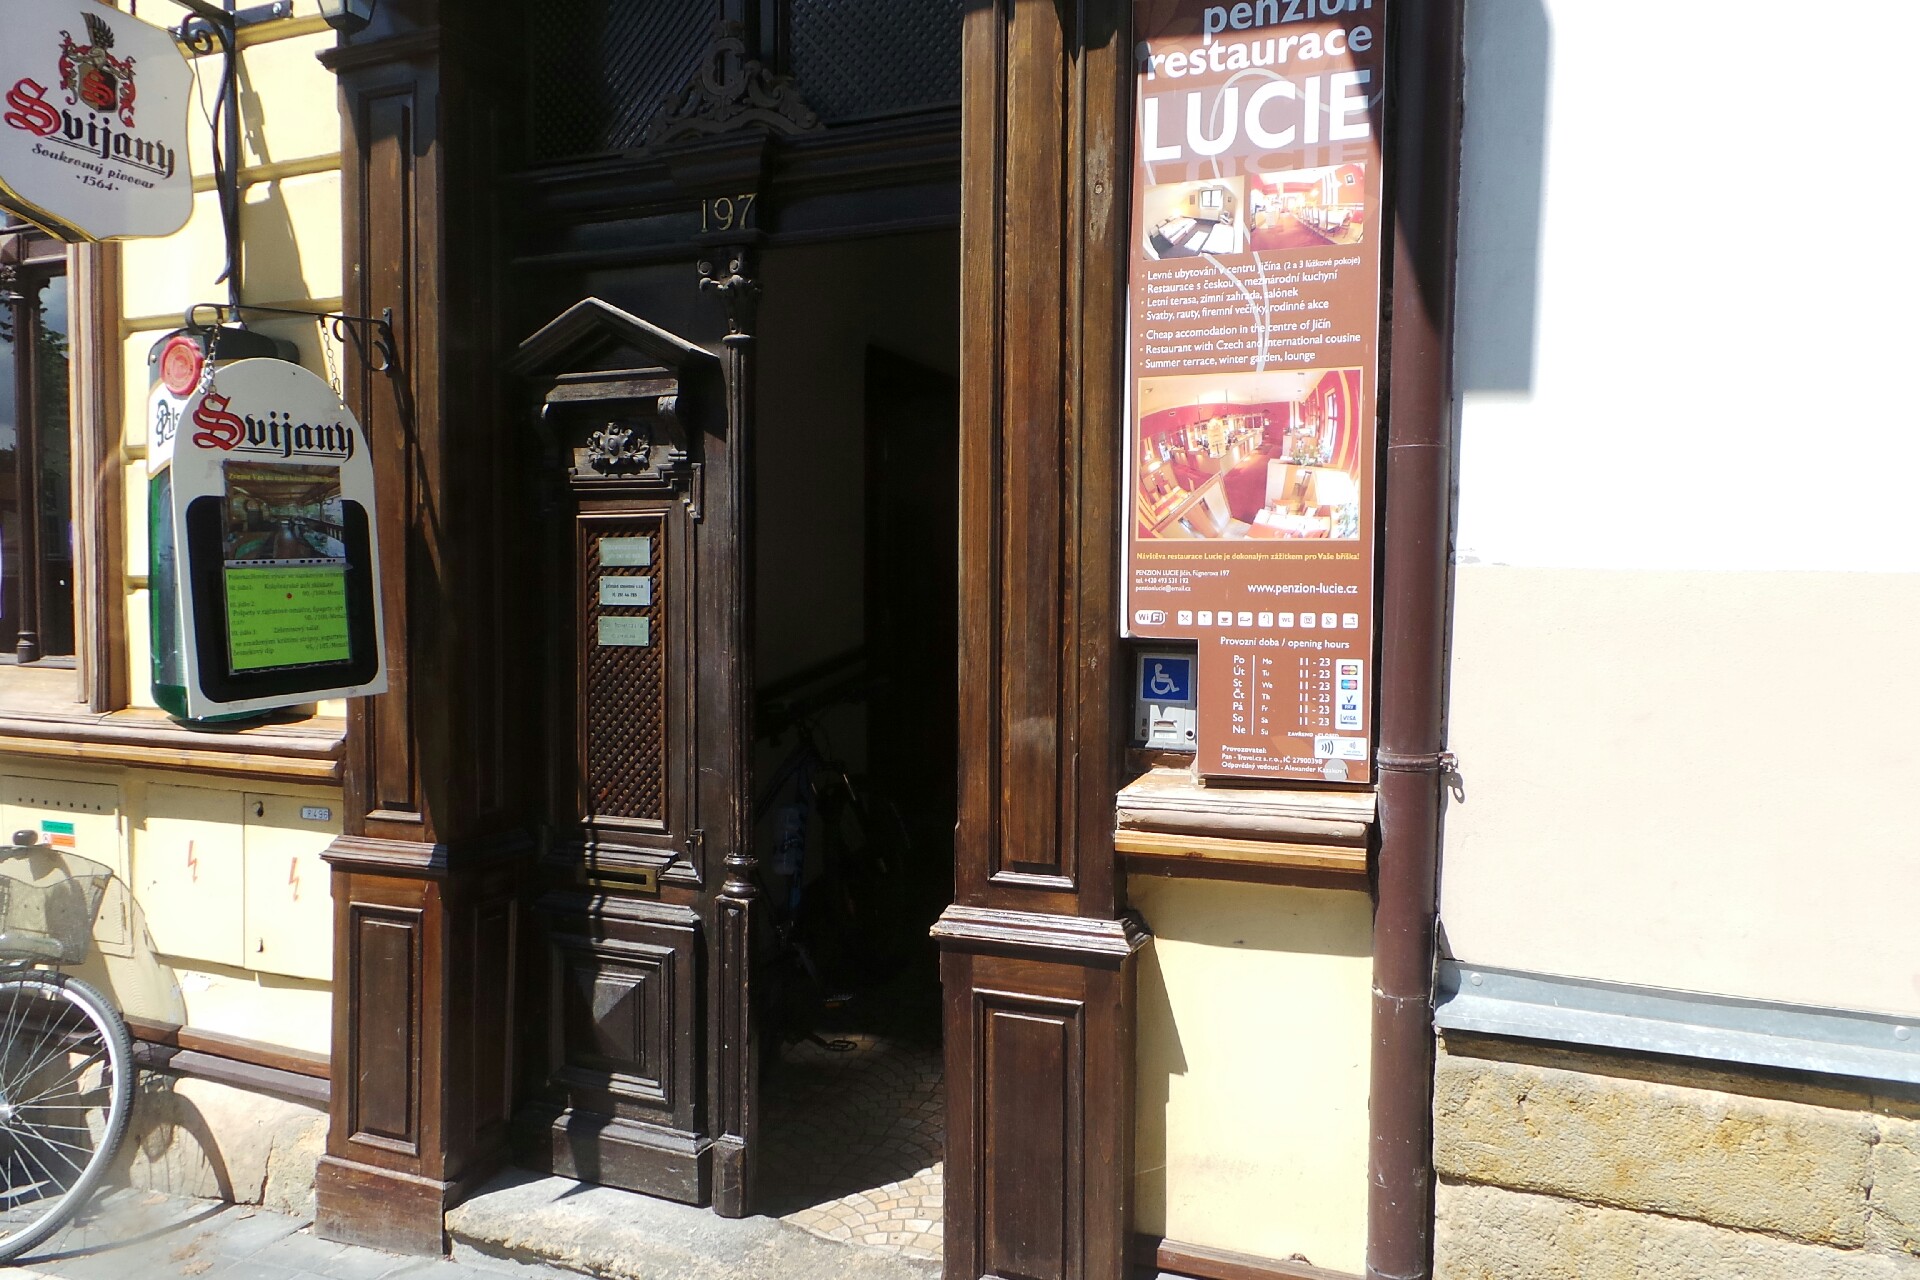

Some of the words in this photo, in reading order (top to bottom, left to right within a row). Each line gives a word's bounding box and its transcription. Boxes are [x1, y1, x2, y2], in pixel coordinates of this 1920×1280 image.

[1147, 25, 1373, 80] restaurace
[1143, 70, 1371, 161] LUCIE
[4, 77, 174, 180] Svijany
[32, 143, 104, 176] Soukromý
[107, 168, 155, 190] pivovar
[701, 193, 758, 233] 197
[1147, 269, 1172, 281] Levné
[1226, 264, 1256, 274] centru
[1299, 260, 1304, 268] 3
[1147, 282, 1194, 294] Restaurace
[1203, 279, 1234, 290] českou
[1302, 269, 1338, 283] kuchyní
[1147, 295, 1168, 307] Letní
[1170, 296, 1199, 306] terasa,
[1200, 292, 1224, 303] zimní
[1225, 289, 1262, 301] zahrada,
[1264, 287, 1299, 298] salónek
[1146, 310, 1175, 322] Svatby,
[1176, 309, 1200, 320] rauty,
[1202, 305, 1234, 316] firemní
[1269, 300, 1305, 312] rodinné
[1307, 300, 1329, 310] akce
[1146, 330, 1174, 341] Cheap
[1175, 325, 1237, 338] accomodation
[1239, 324, 1248, 333] in
[1250, 322, 1265, 333] the
[1268, 322, 1297, 332] centre
[1299, 319, 1310, 329] of
[1311, 318, 1331, 332] Jičín
[1145, 344, 1192, 354] Restaurant
[1194, 341, 1214, 351] with
[1216, 339, 1243, 349] Czech
[1246, 338, 1263, 349] and
[1264, 334, 1323, 347] international
[1325, 333, 1361, 344] cousine
[1145, 358, 1180, 369] Summer
[1183, 357, 1217, 366] terrace,
[1218, 354, 1248, 364] winter
[1249, 352, 1283, 365] garden,
[1284, 351, 1316, 363] lounge
[193, 392, 355, 462] Svijany
[1204, 552, 1222, 560] Lucie
[1223, 553, 1230, 561] je
[1317, 552, 1334, 560] Vaše
[1135, 569, 1161, 577] PENZION
[1162, 569, 1179, 577] LUCIE
[1247, 582, 1358, 596] www.penzion-lucie.cz
[1220, 636, 1257, 646] Provozní
[1258, 638, 1279, 647] doba
[1287, 640, 1323, 650] opening
[1324, 640, 1350, 649] hours
[1233, 655, 1245, 664] Po
[1318, 658, 1331, 666] 23
[1233, 665, 1246, 676] Út
[1261, 669, 1270, 677] Tu
[1318, 670, 1331, 678] 23
[1233, 678, 1243, 688] St
[1318, 682, 1331, 690] 23
[1232, 688, 1245, 699] Čt
[1318, 694, 1331, 702] 23
[1232, 701, 1243, 711] Pá
[1318, 706, 1331, 714] 23
[1232, 713, 1244, 722] So
[1318, 718, 1331, 726] 23
[1232, 725, 1246, 734] Ne
[1260, 728, 1269, 736] Su
[1221, 745, 1267, 754] Provozovatel:
